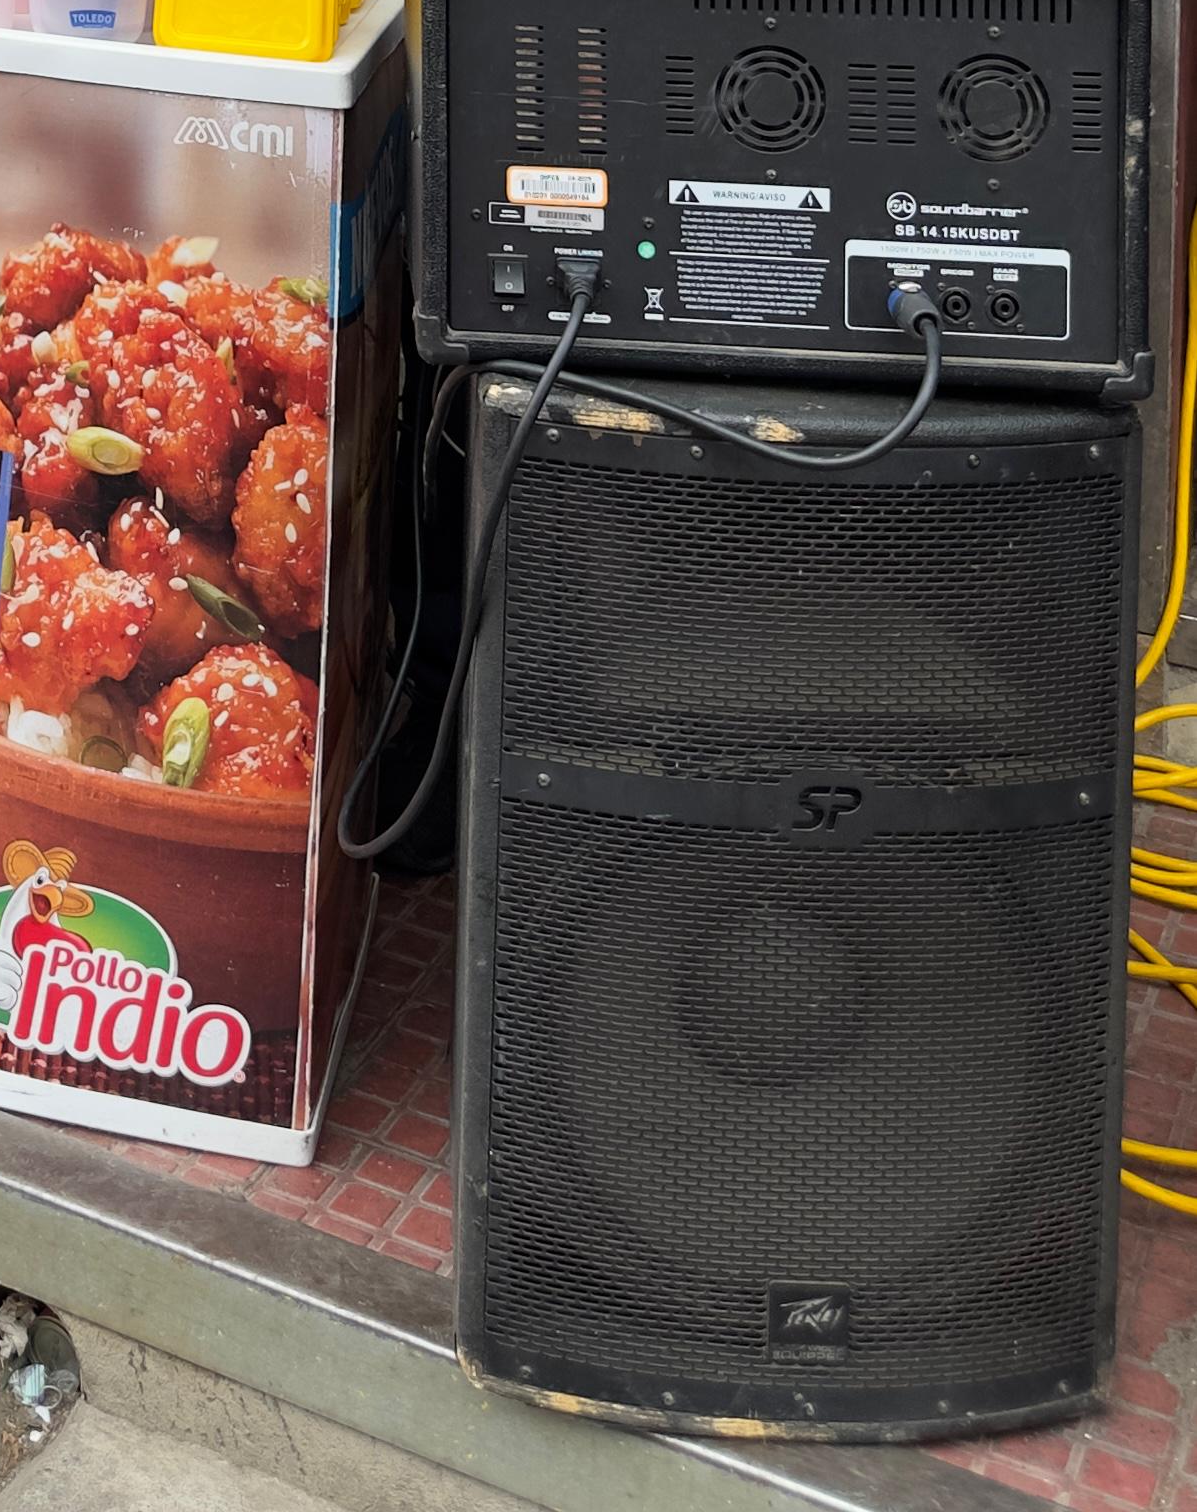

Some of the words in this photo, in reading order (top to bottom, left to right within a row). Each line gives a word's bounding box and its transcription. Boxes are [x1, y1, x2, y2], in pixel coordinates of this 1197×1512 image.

[71, 12, 115, 25] TOLEDO
[712, 190, 786, 202] WARNING/AVISO
[920, 202, 1022, 218] soundbarrier
[894, 223, 1020, 242] SB-14.15KUSDBT
[791, 786, 863, 832] SP
[48, 939, 144, 994] Pollo
[13, 950, 245, 1078] Indio
